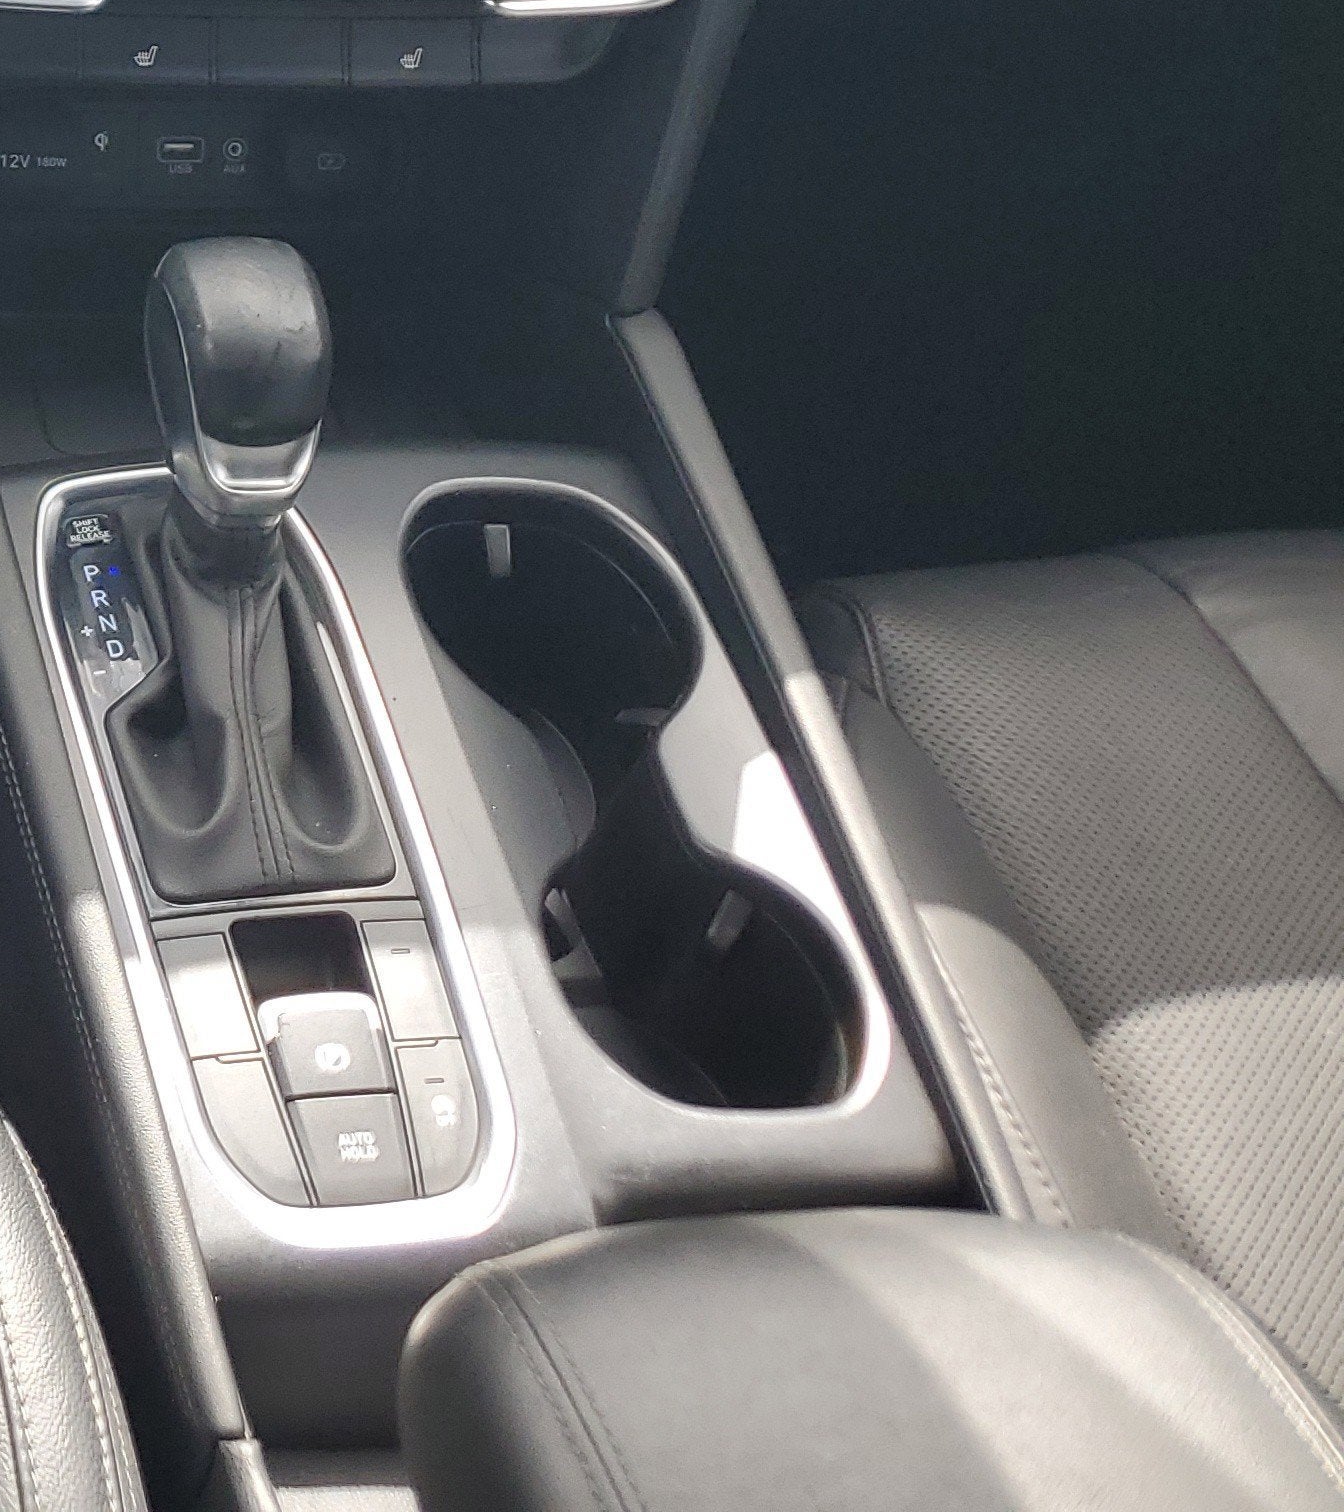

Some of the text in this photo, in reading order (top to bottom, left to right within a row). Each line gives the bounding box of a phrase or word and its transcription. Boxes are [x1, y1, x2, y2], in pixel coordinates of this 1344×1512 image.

[0, 154, 31, 168] 12V
[72, 518, 99, 529] SHIFT
[76, 525, 100, 534] LOCK
[70, 530, 110, 543] RELEASE
[83, 565, 100, 582] P
[91, 590, 110, 607] R
[98, 613, 117, 632] N
[105, 639, 124, 658] D
[338, 1131, 376, 1147] AUTO
[339, 1146, 380, 1162] HOLD
